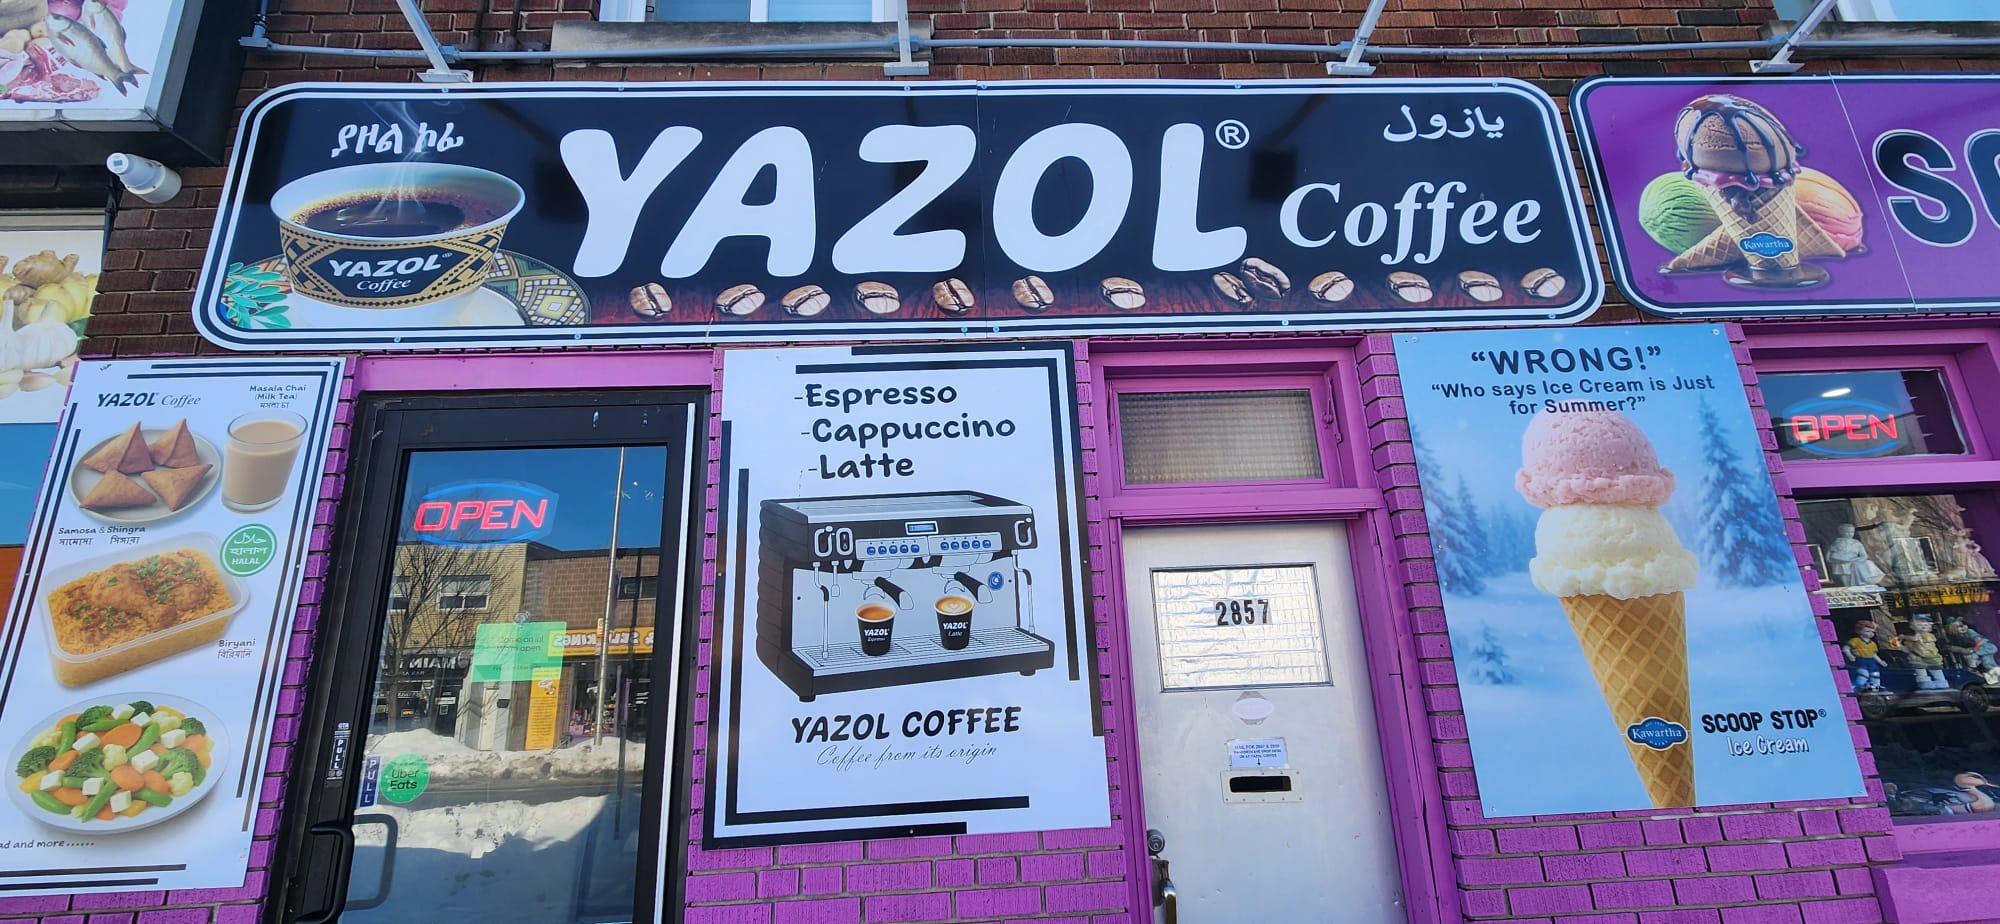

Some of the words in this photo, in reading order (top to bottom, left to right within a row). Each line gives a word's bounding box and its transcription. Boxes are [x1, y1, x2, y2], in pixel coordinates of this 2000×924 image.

[1383, 105, 1505, 142] يازول
[1279, 181, 1542, 265] Coffee
[1743, 240, 1790, 250] Kawartha
[356, 279, 412, 293] Coffee
[249, 384, 283, 392] Masala
[285, 384, 306, 392] Chai
[1492, 383, 1537, 397] says
[1543, 380, 1573, 395] Ice
[1579, 377, 1644, 393] Cream
[1649, 376, 1667, 391] is
[1672, 374, 1716, 390] Just
[161, 394, 201, 409] Coffee
[254, 393, 276, 401] (Milk
[278, 393, 298, 401] Tea)
[1509, 400, 1538, 415] for
[1791, 414, 1898, 441] OPEN
[413, 499, 548, 531] OPEN
[58, 527, 97, 535] Samosa
[98, 526, 106, 534] &
[107, 525, 146, 535] Shingra
[1215, 599, 1269, 626] 2857
[218, 638, 256, 649] Biryani
[791, 713, 890, 743] YAZOL
[902, 706, 1021, 738] COFFEE
[1701, 712, 1763, 734] SCOOP
[1632, 727, 1682, 740] Kawartha
[333, 739, 344, 769] PULL
[1728, 737, 1752, 756] Ice
[1756, 735, 1809, 756] Cream
[816, 745, 872, 772] Coffee
[873, 744, 915, 770] from
[920, 745, 943, 760] its
[944, 743, 998, 765] origin
[364, 759, 377, 803] PULL
[391, 769, 419, 779] Uber
[390, 780, 417, 790] Eats
[13, 840, 35, 849] and
